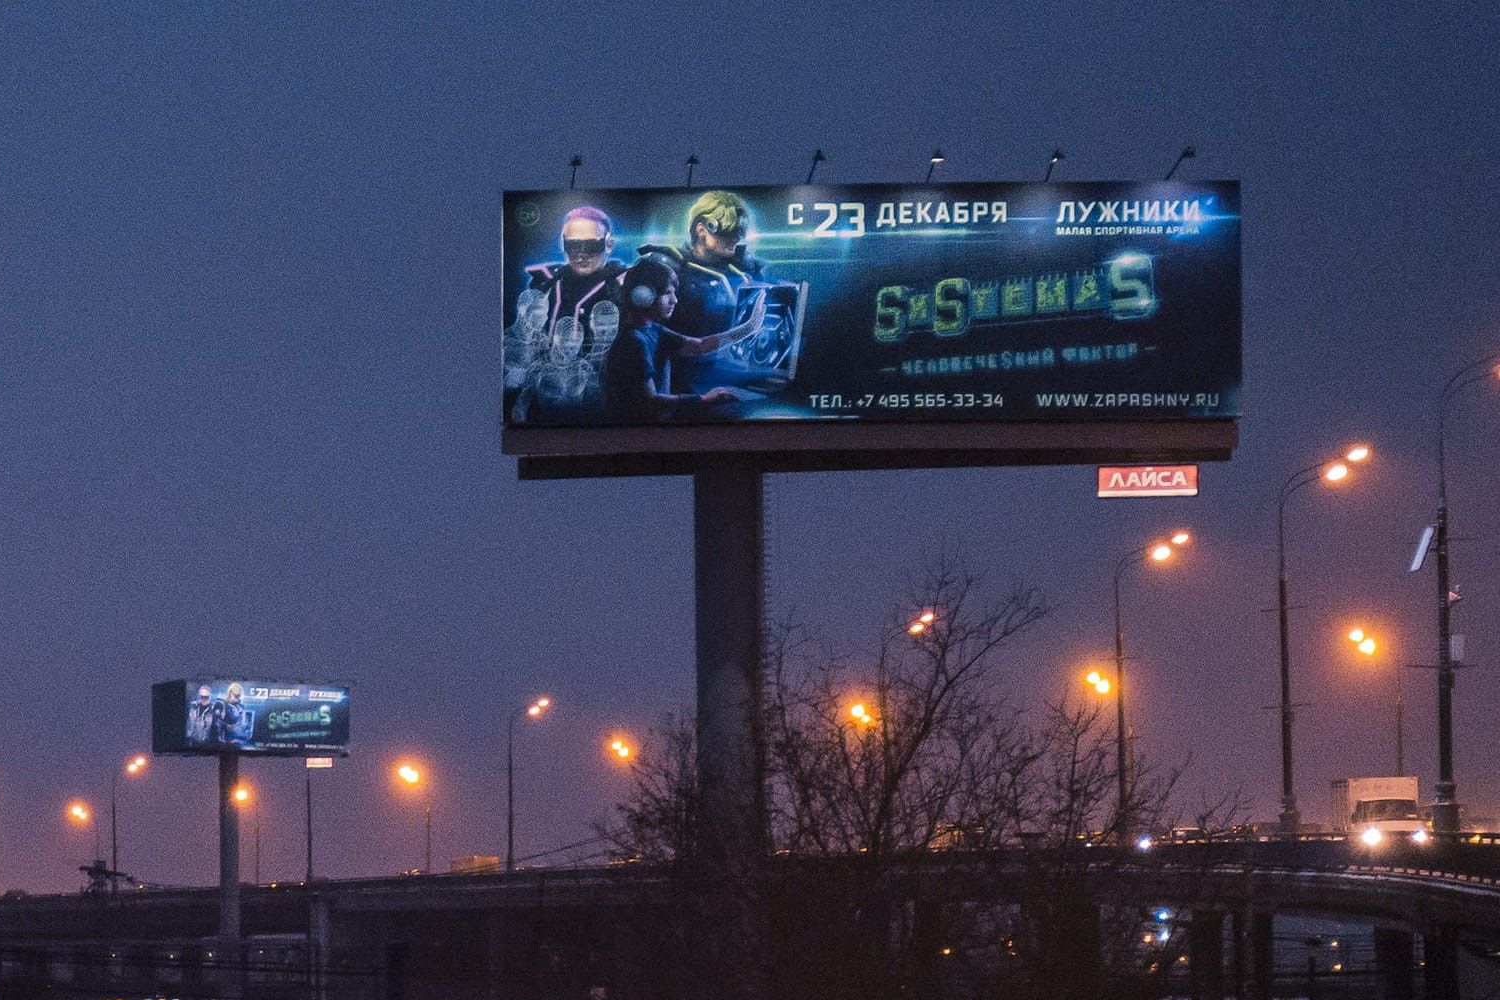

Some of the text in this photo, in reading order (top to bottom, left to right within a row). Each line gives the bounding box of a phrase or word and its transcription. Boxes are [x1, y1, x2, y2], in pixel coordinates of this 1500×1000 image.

[787, 200, 1008, 238] С 23 ДЕКАБРЯ
[1056, 200, 1201, 224] ЛУЖНИКИ
[1056, 225, 1200, 236] МАЛАЯ СПОРТИВНАЯ АРЕНА
[809, 392, 1004, 408] ТЕЛ.: +7 495 565-33-34
[1036, 392, 1220, 408] WWW.ZAPASHNY.RU
[1108, 467, 1188, 488] ЛАЙСА
[255, 687, 269, 700] 23
